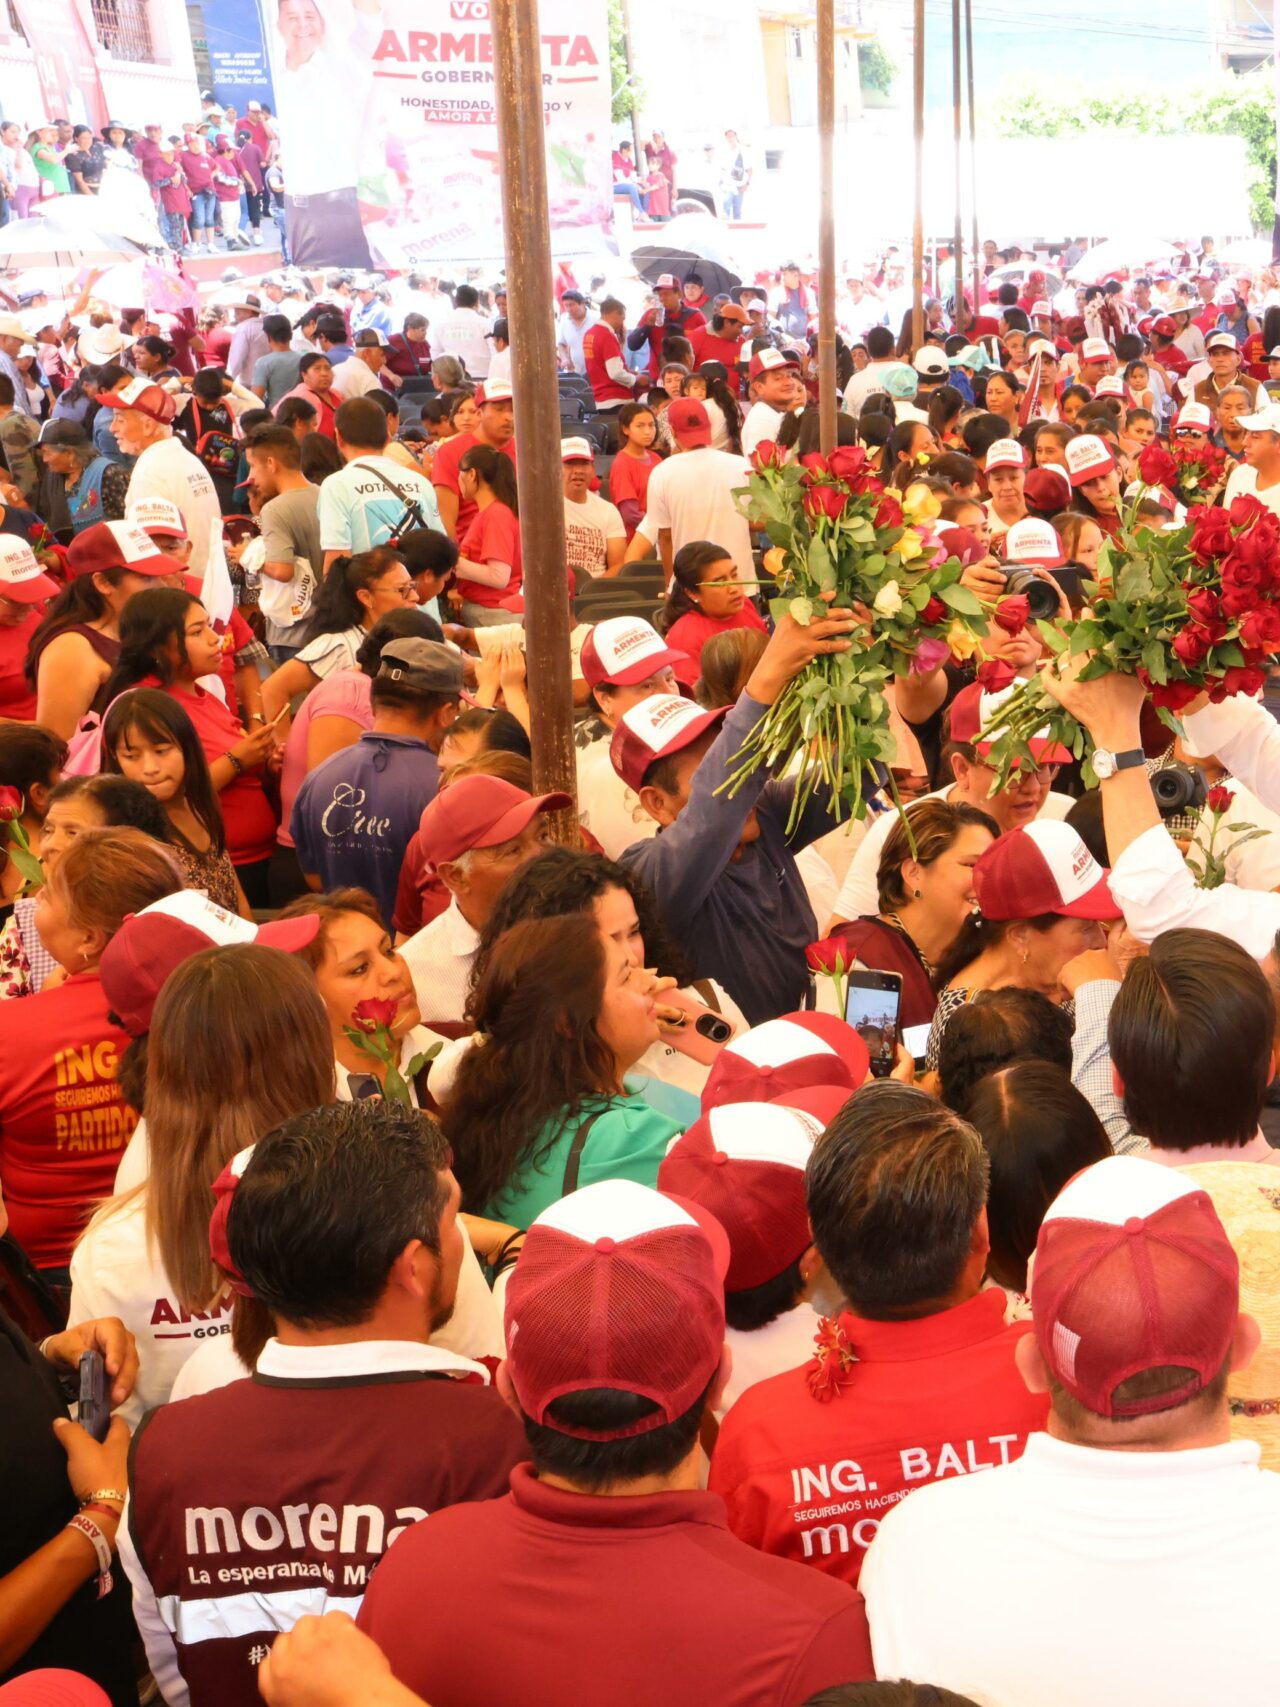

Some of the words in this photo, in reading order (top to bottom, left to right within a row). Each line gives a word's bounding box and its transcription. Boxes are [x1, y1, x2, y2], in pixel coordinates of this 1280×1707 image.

[372, 30, 599, 66] ARMETA
[421, 70, 553, 85] GOBERNR
[427, 111, 472, 123] AMOR
[354, 482, 389, 494] VOTA
[613, 630, 655, 656] ARMENTA
[55, 1084, 111, 1107] SEGUIREMOS
[790, 1459, 878, 1504] ING.
[900, 1433, 1019, 1481] BALT
[794, 1499, 862, 1522] SEGUIREMOS
[188, 1566, 211, 1585] La
[217, 1561, 321, 1585] esperanza
